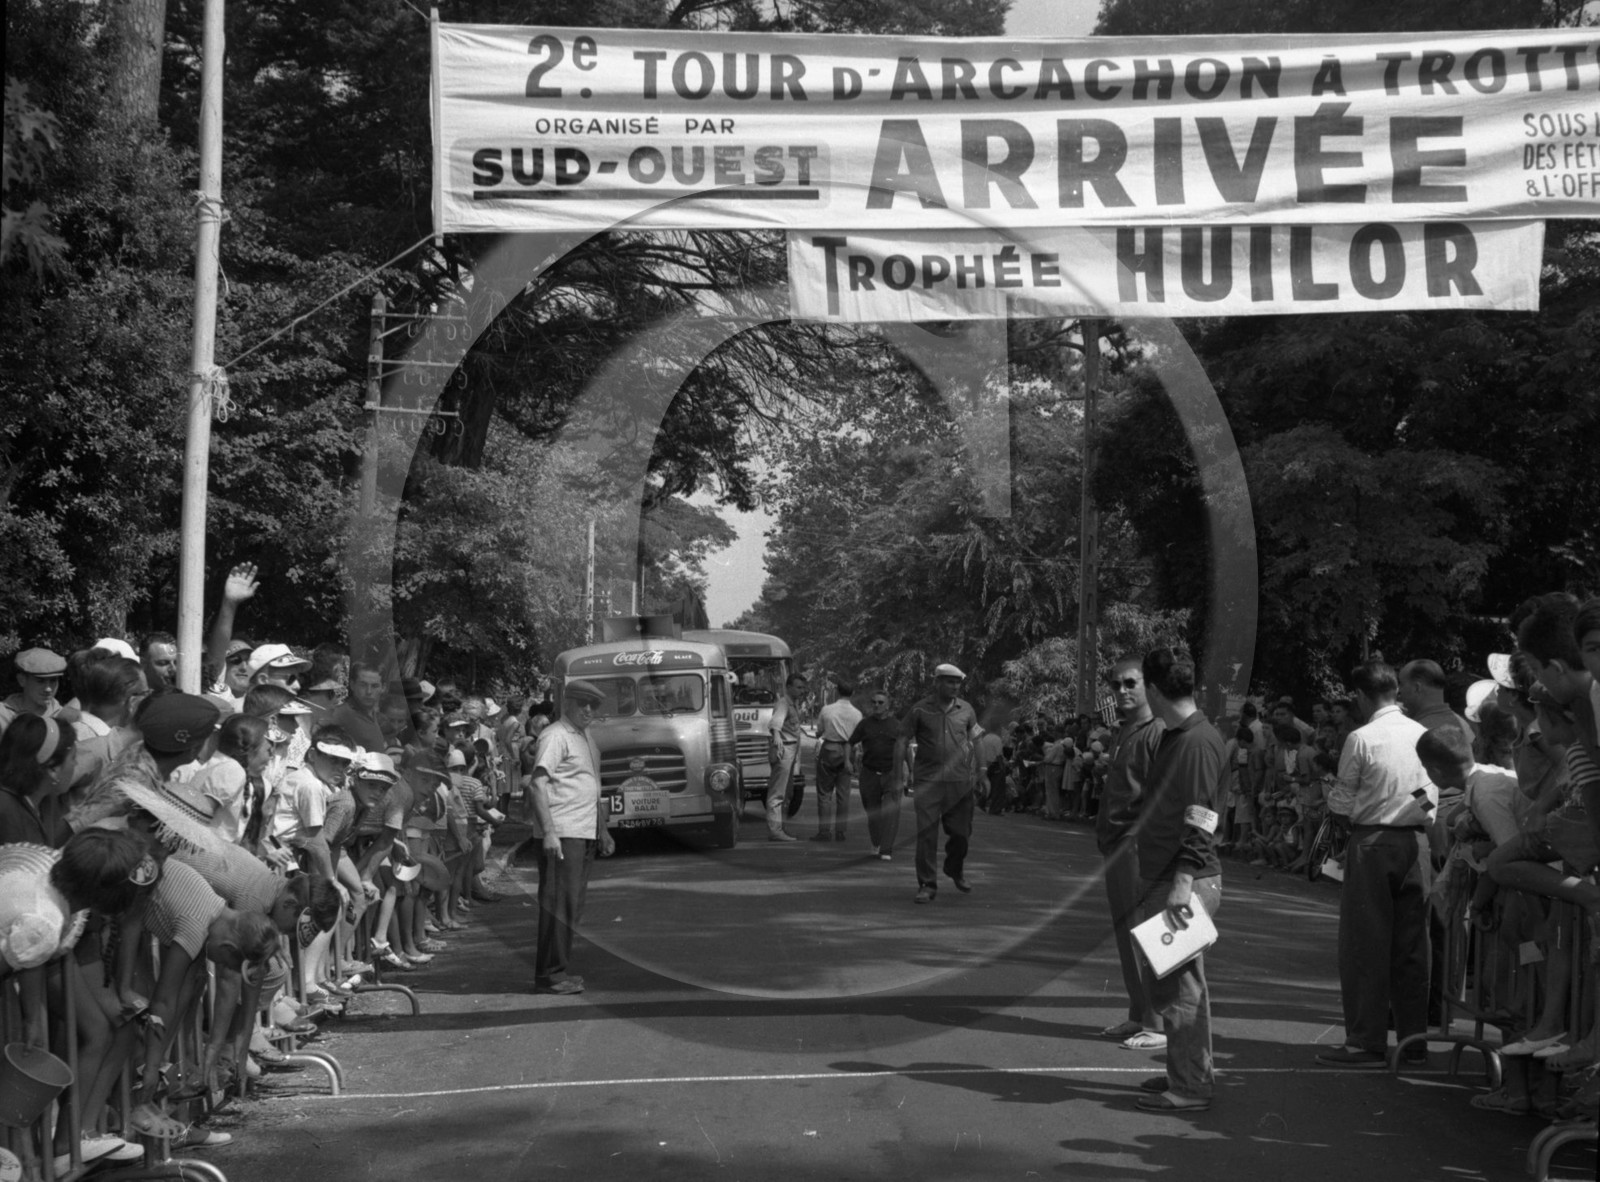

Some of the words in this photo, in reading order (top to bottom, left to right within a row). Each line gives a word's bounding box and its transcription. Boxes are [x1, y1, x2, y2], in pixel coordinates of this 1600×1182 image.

[633, 50, 807, 101] TOUR
[832, 55, 1282, 101] D'ARCACHON
[1376, 45, 1600, 96] TROTT
[535, 116, 659, 135] ORGANISÉ
[685, 118, 735, 135] PAR
[1523, 112, 1587, 137] SOUS
[472, 145, 819, 188] SUD-OUEST
[865, 102, 1469, 210] ARRIVÉE
[1523, 143, 1556, 170] DES
[1564, 141, 1600, 169] FÊT
[812, 236, 1061, 315] TROPHÉE
[1115, 222, 1484, 303] HUILOR
[613, 650, 665, 666] Coca-Cola
[611, 795, 623, 812] 13
